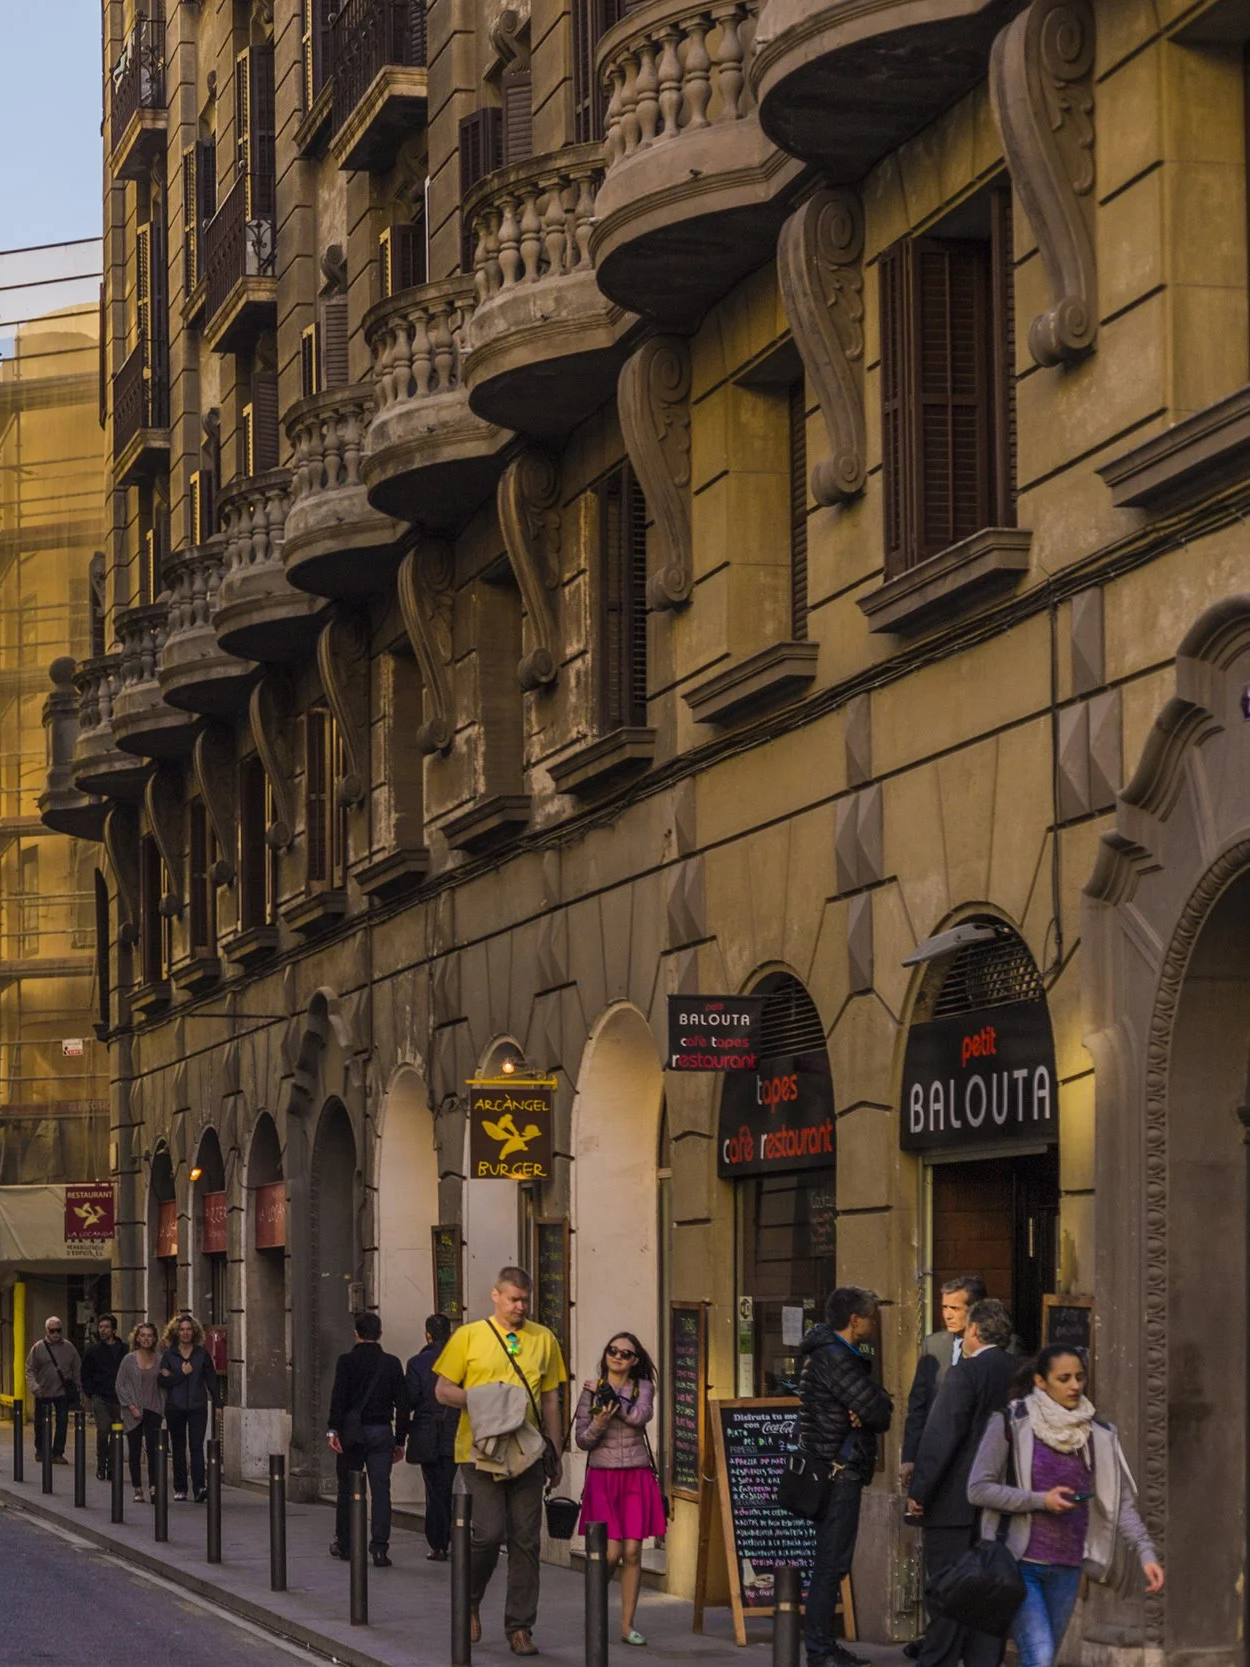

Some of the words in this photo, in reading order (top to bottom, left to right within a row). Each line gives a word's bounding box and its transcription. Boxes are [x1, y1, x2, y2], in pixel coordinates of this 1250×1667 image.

[679, 1013, 751, 1026] BALOUTA
[711, 1036, 750, 1052] tapes
[962, 1026, 997, 1068] petit
[672, 1052, 757, 1068] restaurant
[756, 1074, 798, 1114] tapes
[910, 1065, 1050, 1134] BALOUTA
[474, 1094, 550, 1112] ARCÀNGEL
[760, 1117, 833, 1160] restaurant
[477, 1161, 548, 1178] BURGER
[67, 1191, 112, 1199] RESTAURANT
[733, 1413, 770, 1421] Disfruta
